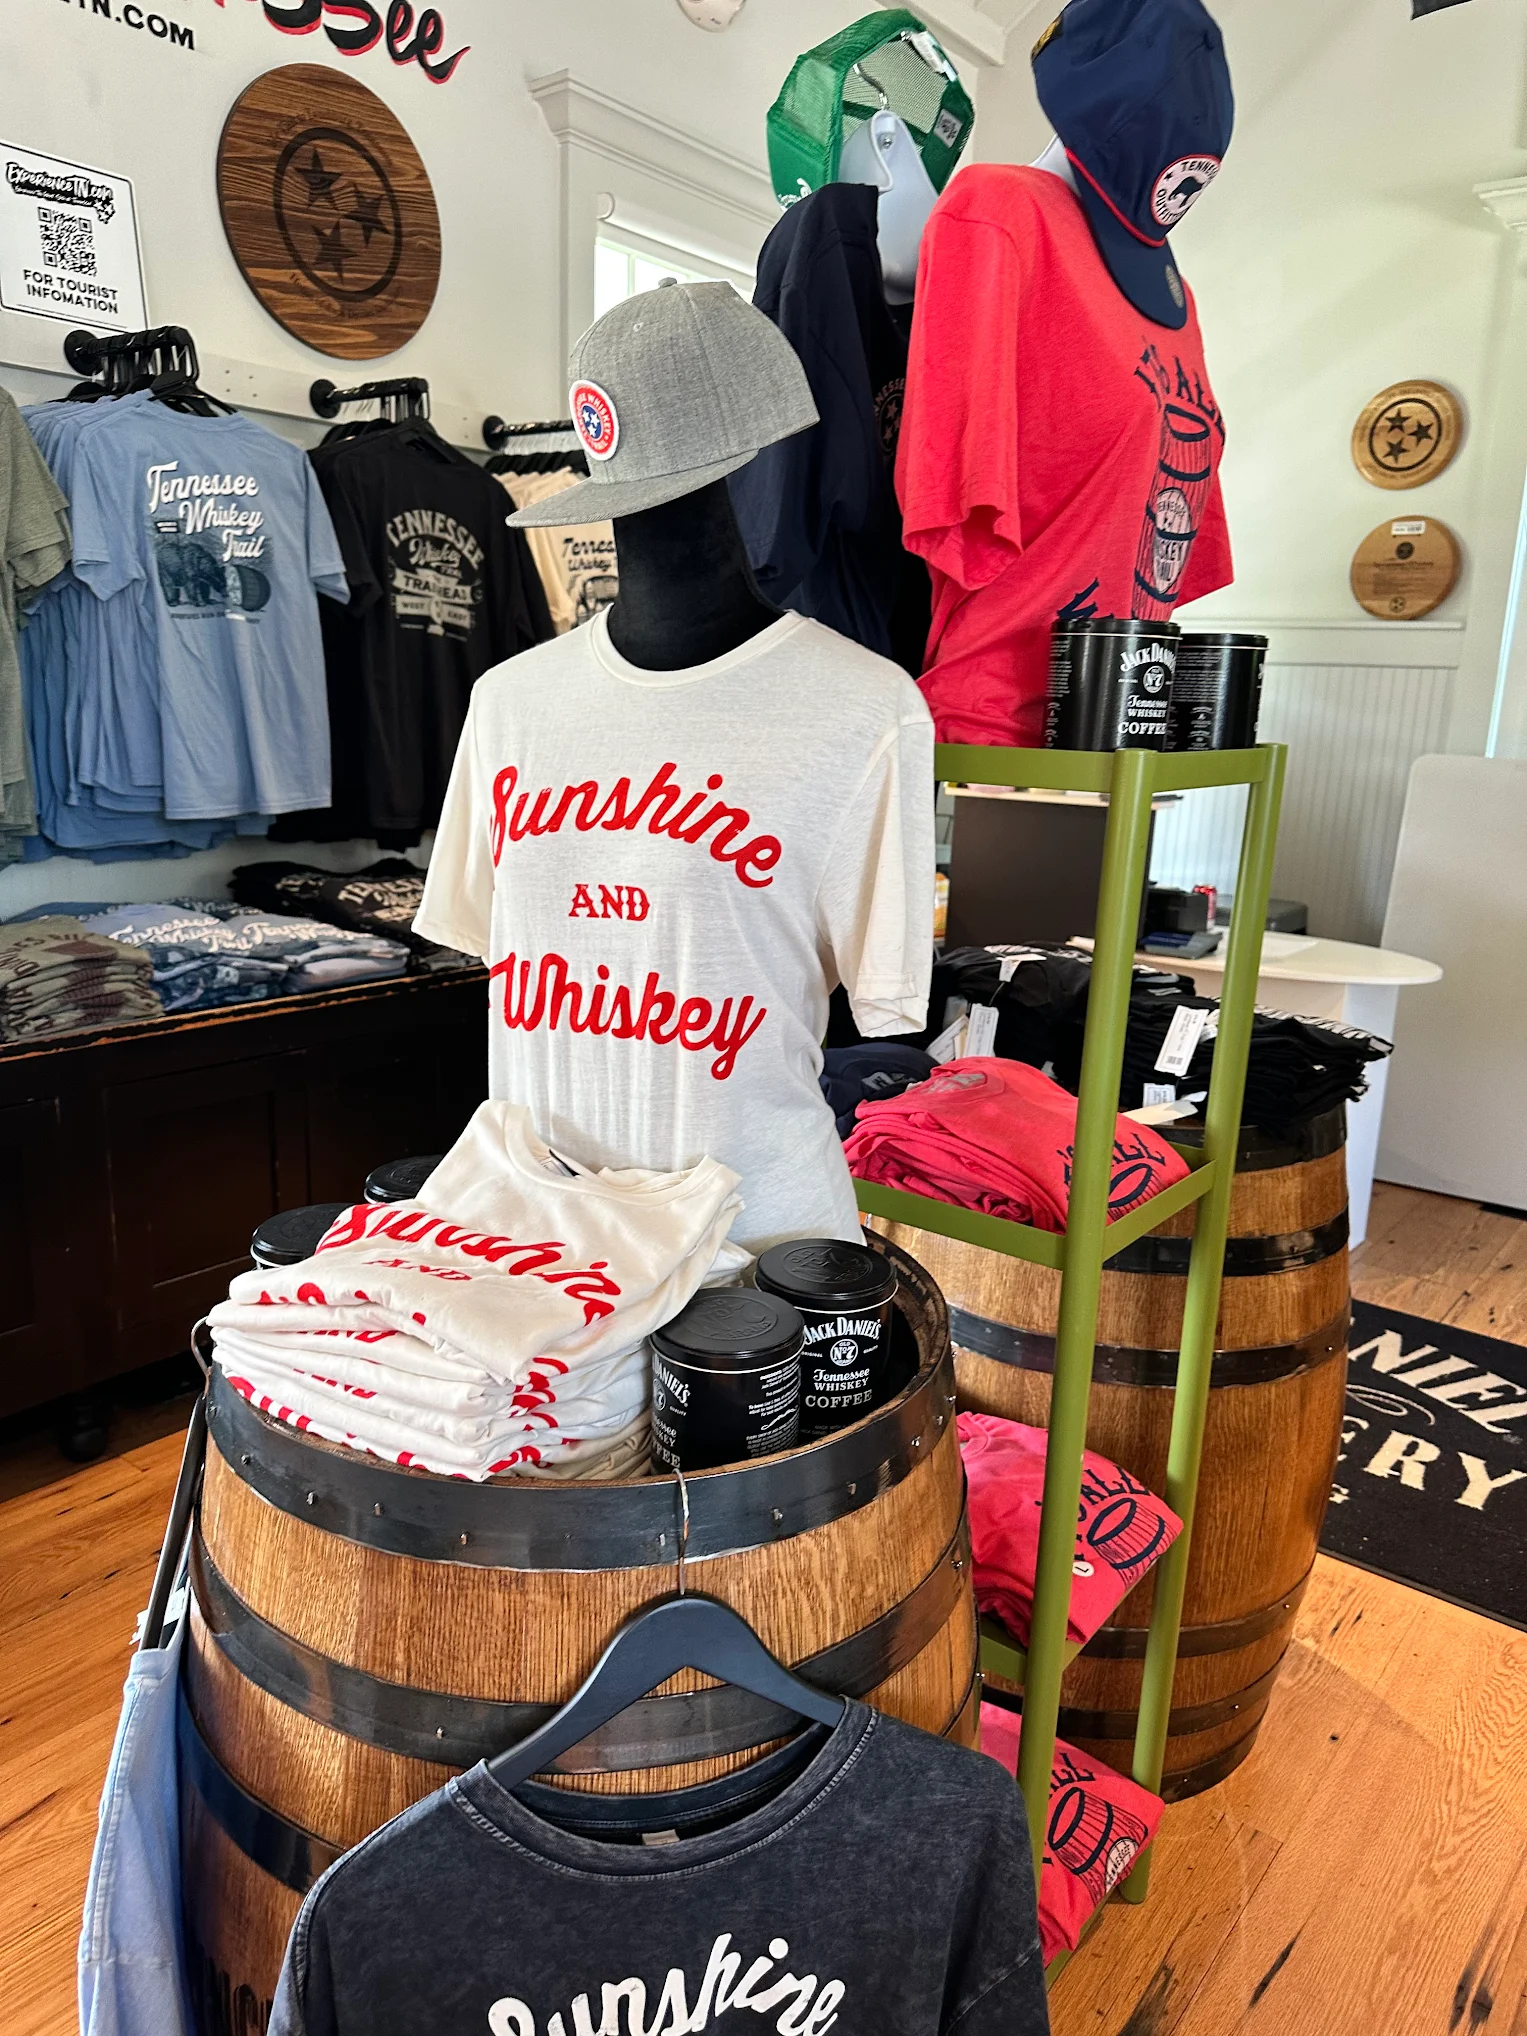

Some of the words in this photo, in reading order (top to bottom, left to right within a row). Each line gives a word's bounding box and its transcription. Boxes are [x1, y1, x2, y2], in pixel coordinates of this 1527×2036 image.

[23, 268, 53, 287] FOR
[56, 276, 118, 301] TOURIST
[26, 283, 119, 314] INFOMATION
[147, 460, 260, 515] Tennessee
[179, 497, 265, 535] Whiskey
[222, 528, 266, 562] Trail
[385, 509, 485, 571] TENNESSEE
[1119, 649, 1151, 673] JACK
[1117, 721, 1168, 735] COFFEE
[1127, 708, 1167, 718] WHISKEY
[490, 761, 782, 889] Sunshine
[568, 883, 651, 922] AND
[489, 951, 767, 1081] Whiskey
[803, 1321, 837, 1346] JACK
[836, 1316, 883, 1341] DANIEL'S
[813, 1368, 871, 1382] Tennessee
[813, 1377, 869, 1392] WHISKEY
[804, 1393, 873, 1409] COFFEE
